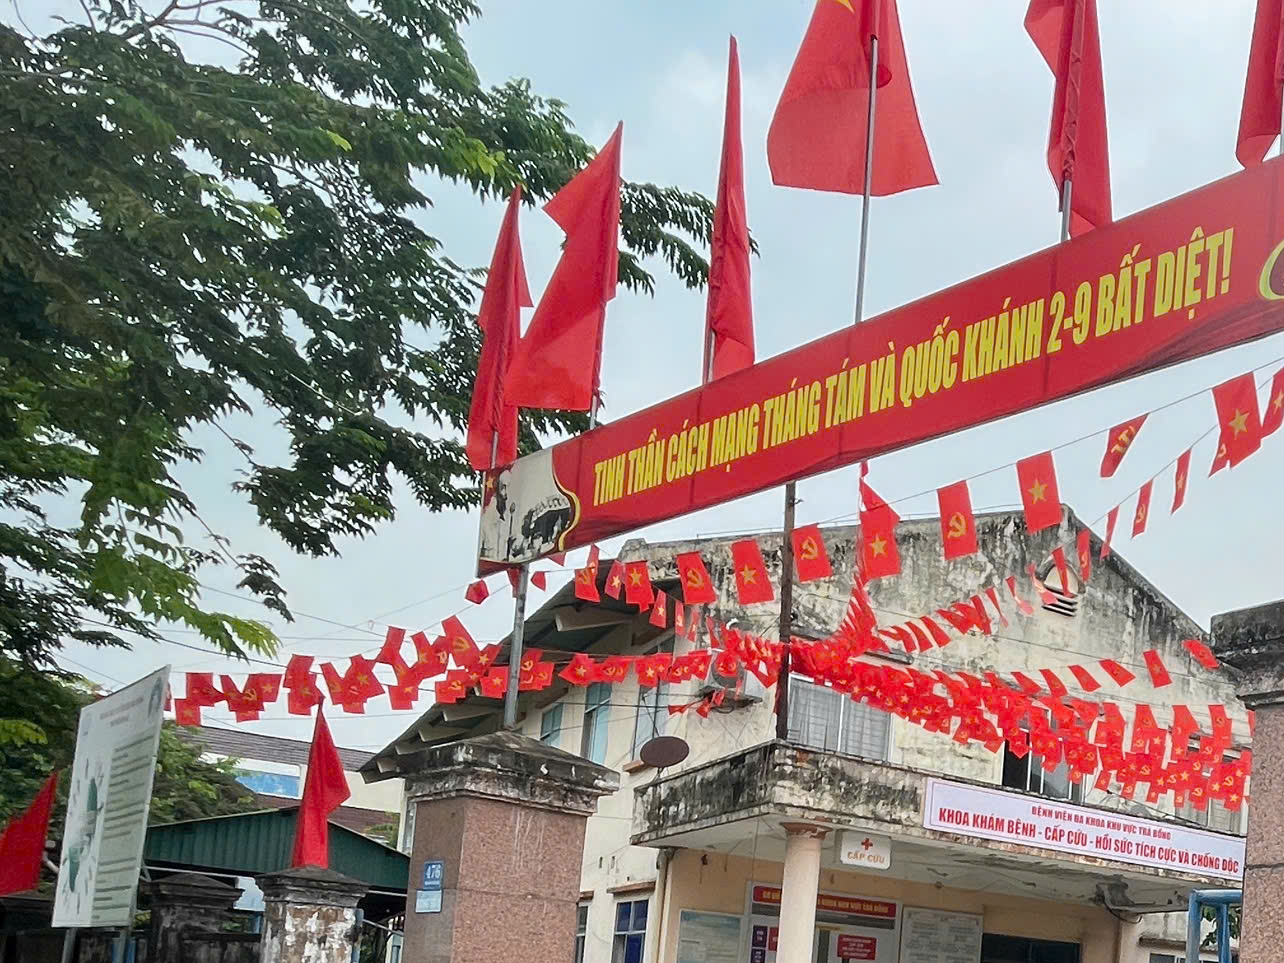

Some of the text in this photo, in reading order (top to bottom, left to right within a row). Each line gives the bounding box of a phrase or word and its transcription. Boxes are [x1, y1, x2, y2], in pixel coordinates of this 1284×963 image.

[593, 225, 1234, 507] TINH THẦN CÁCH MẠNG THÁNG TÁM VÀ QUỐC KHÁNH 2-9 BẤT DIỆT!
[939, 807, 969, 826] KHOA
[972, 813, 1004, 833] KHÁM
[1007, 818, 1036, 839] BỆNH
[1044, 823, 1065, 842] CẤP
[1067, 827, 1087, 847] CỨU
[1095, 833, 1111, 850] HỒI
[1114, 836, 1132, 854] SỨC
[1135, 841, 1156, 858] TÍCH
[1158, 846, 1176, 864] CỰC
[1178, 847, 1189, 865] VÀ
[1191, 850, 1220, 870] CHỐNG
[1085, 816, 1105, 829] KHOA
[1107, 820, 1122, 832] KHU
